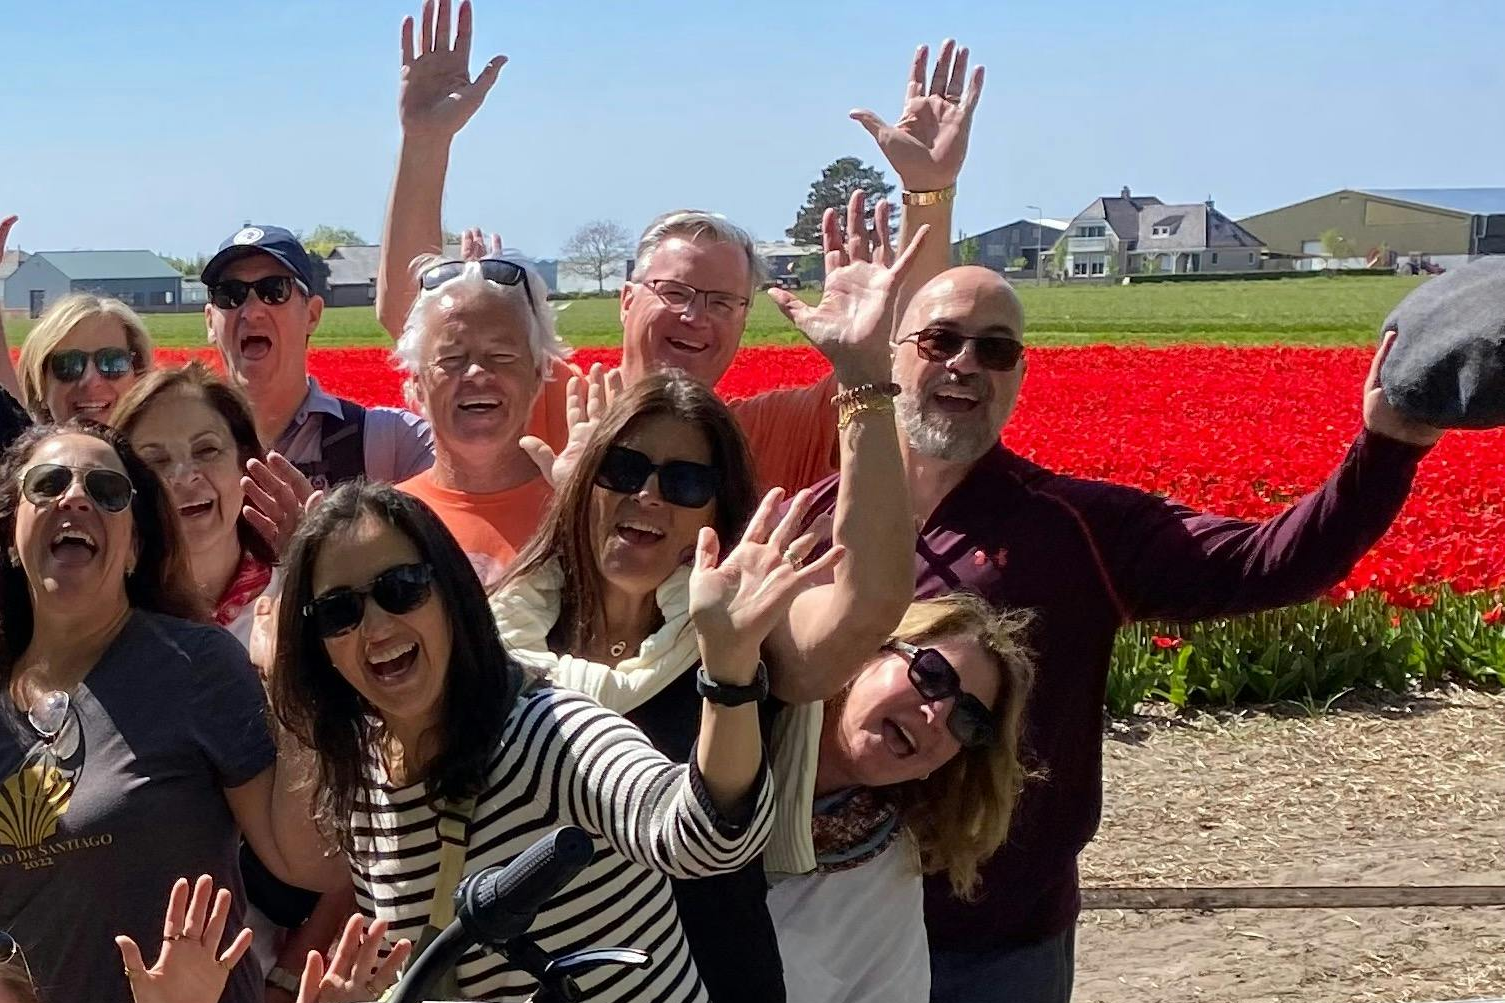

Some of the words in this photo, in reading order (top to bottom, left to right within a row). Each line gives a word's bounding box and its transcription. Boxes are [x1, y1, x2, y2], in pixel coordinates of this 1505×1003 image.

[16, 849, 33, 861] DE
[38, 834, 112, 855] SANTIAGO
[23, 857, 53, 870] 2022
